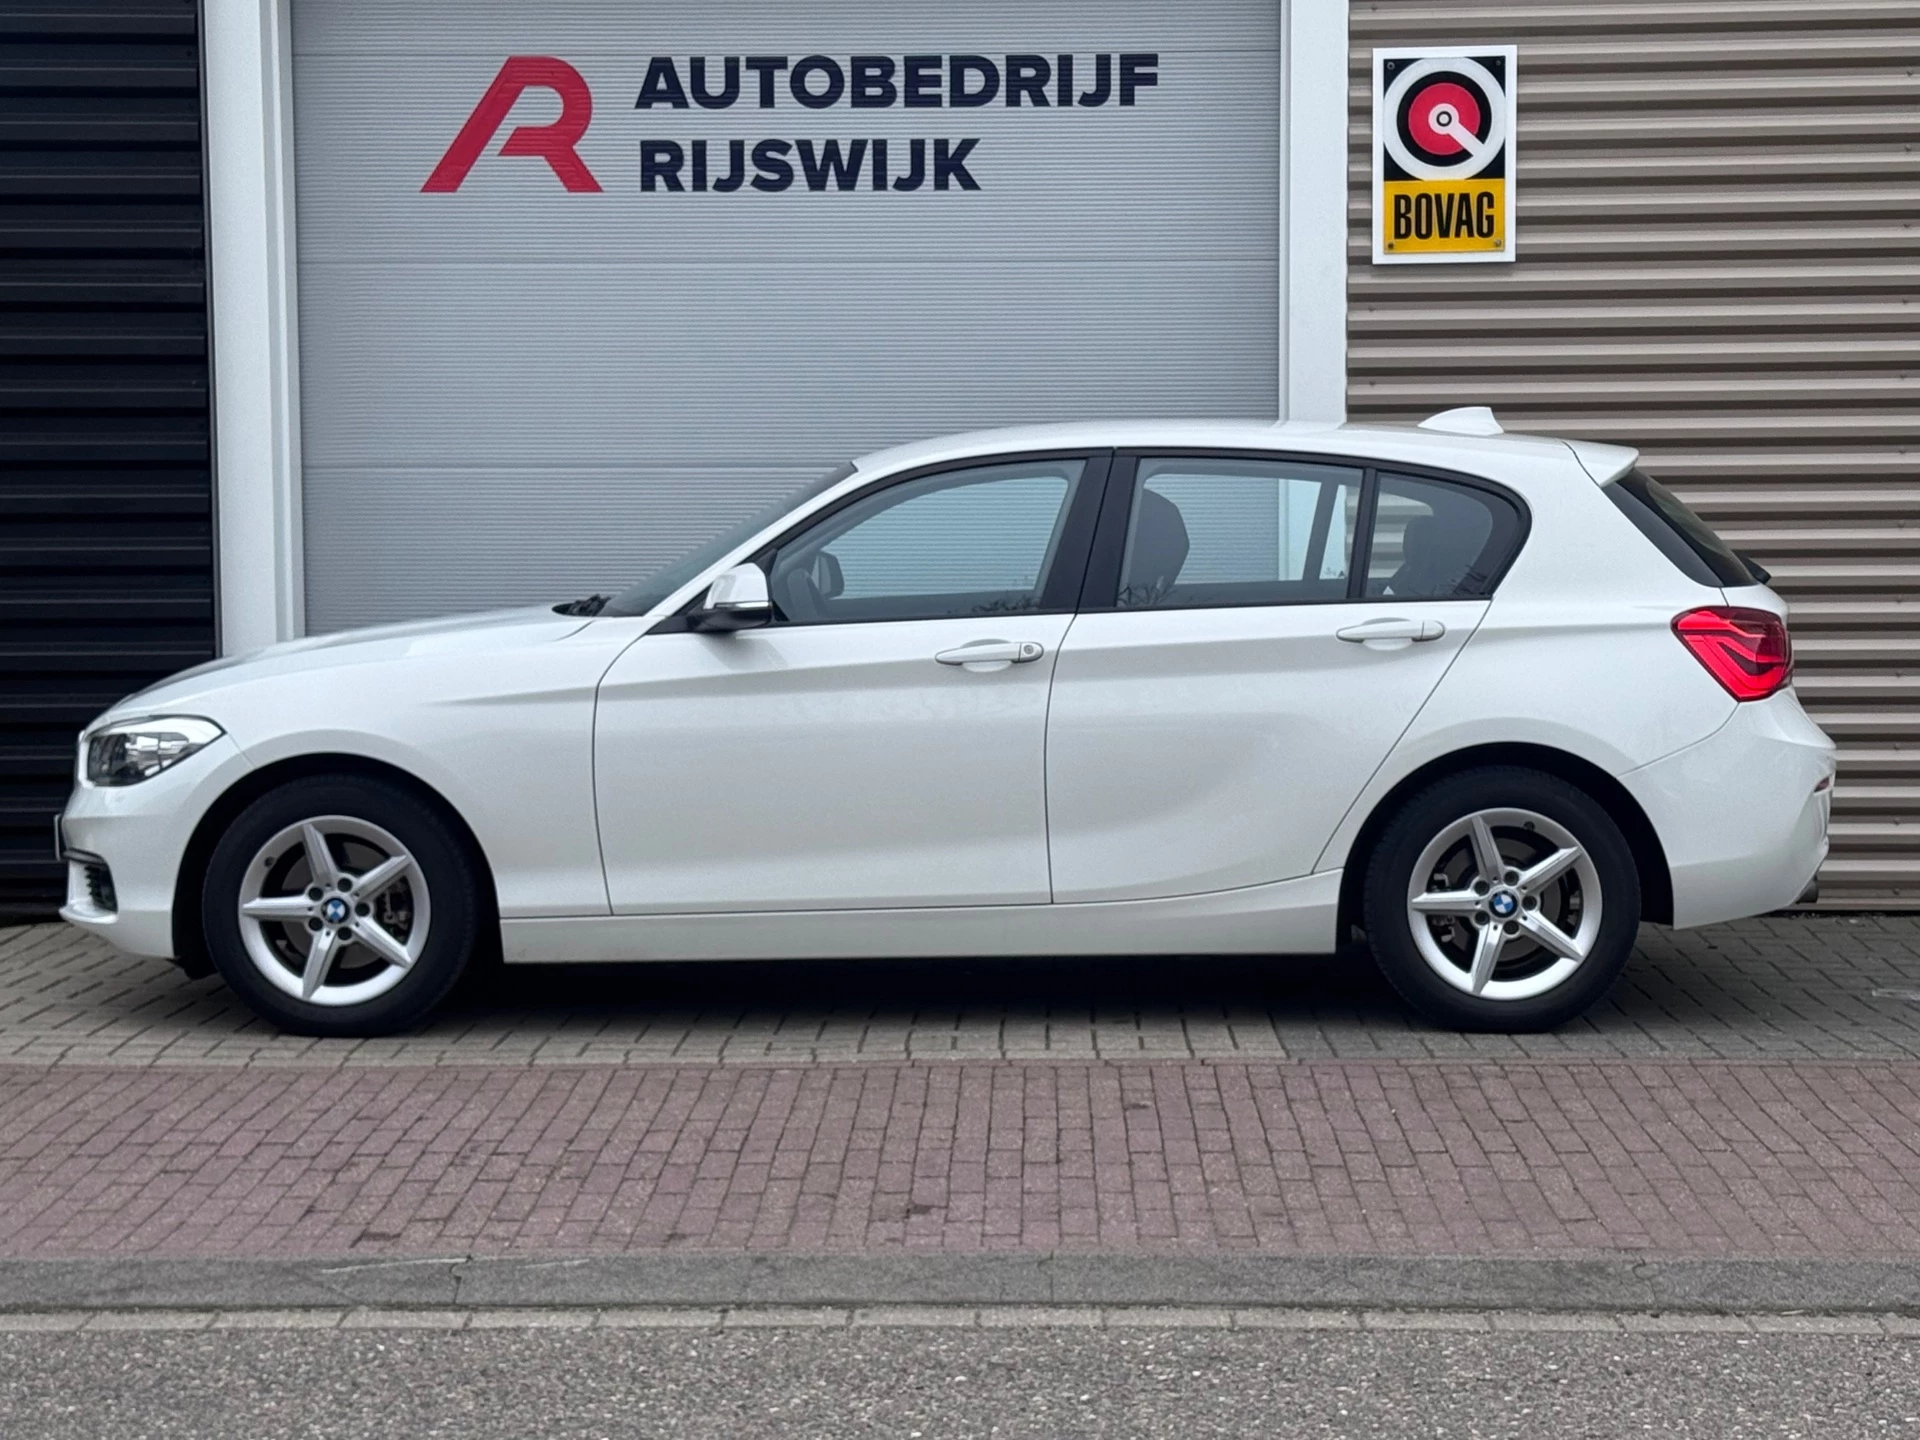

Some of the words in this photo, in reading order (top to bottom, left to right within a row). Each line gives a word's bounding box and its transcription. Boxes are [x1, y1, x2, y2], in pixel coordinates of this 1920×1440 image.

[634, 53, 1159, 110] AUTOBEDRIJF
[640, 138, 982, 193] RIJSWIJK
[1393, 191, 1495, 240] BOVAG
